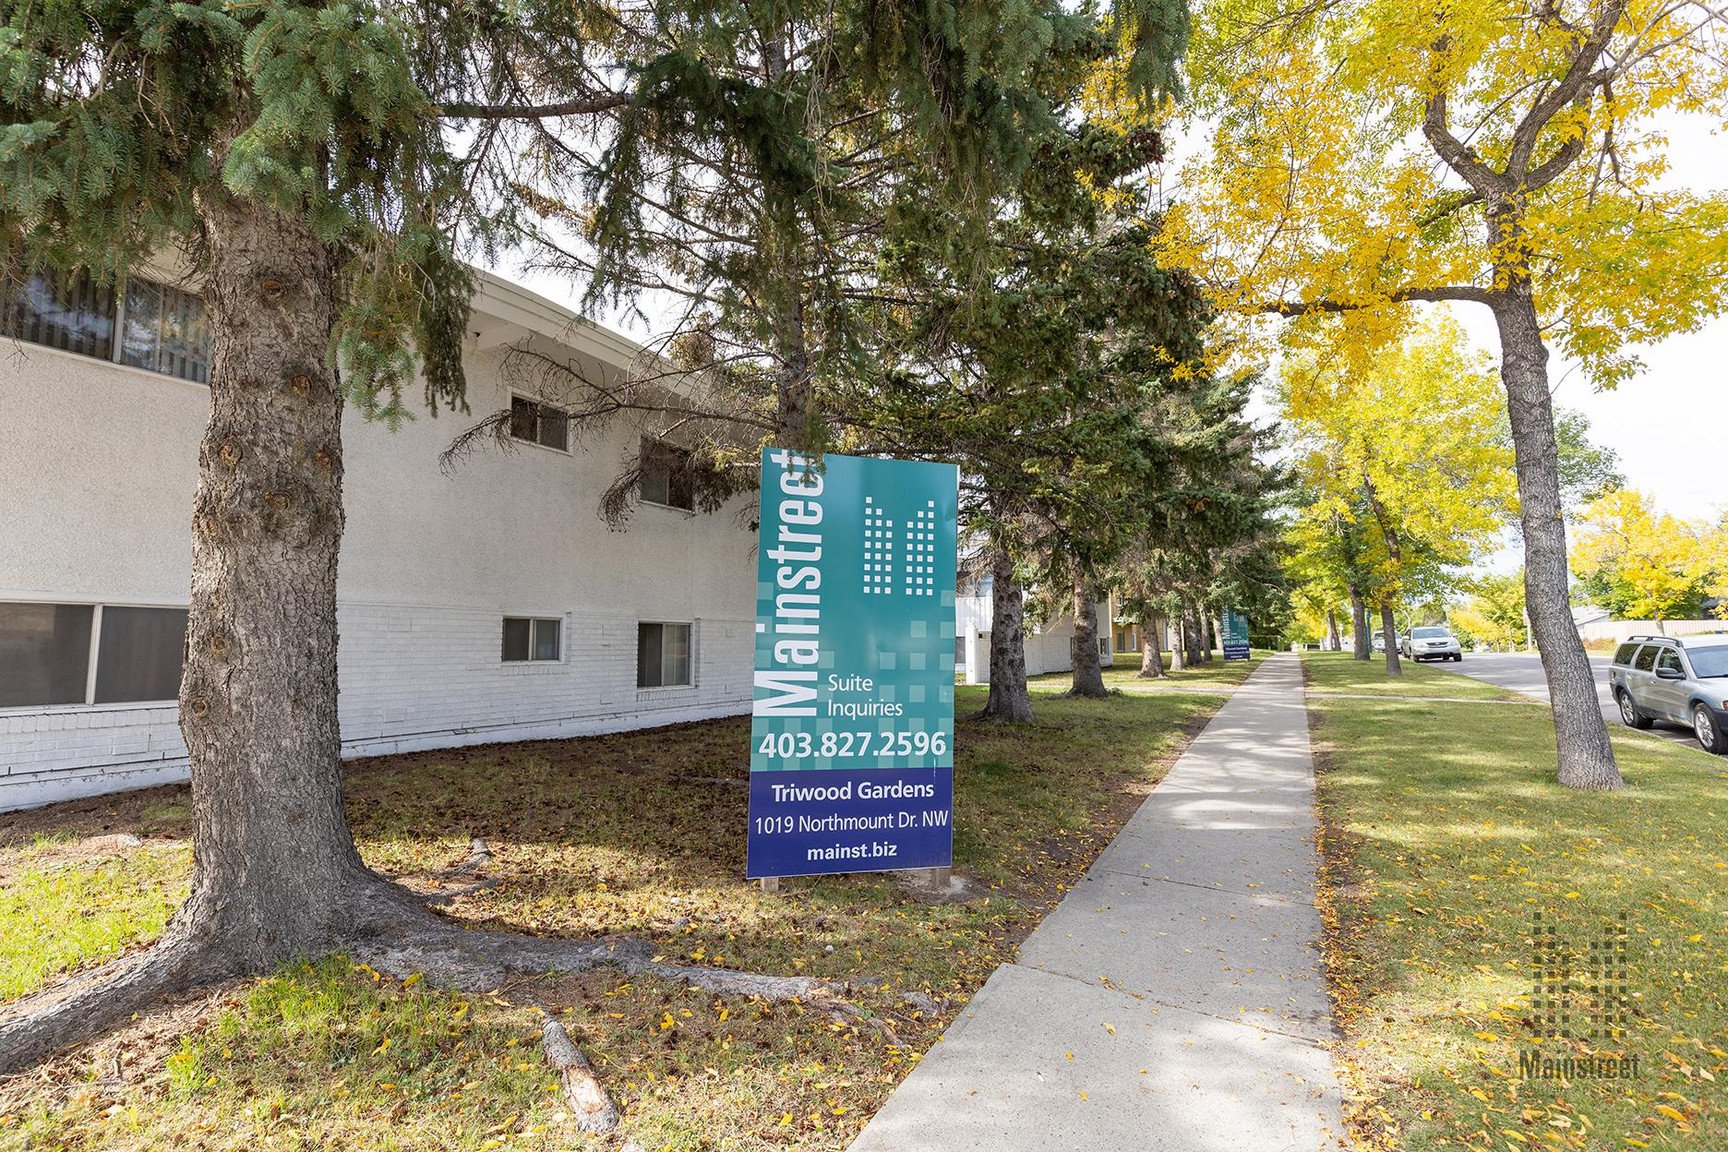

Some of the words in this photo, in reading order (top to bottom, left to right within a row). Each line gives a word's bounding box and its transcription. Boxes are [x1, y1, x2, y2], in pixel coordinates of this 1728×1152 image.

[753, 450, 824, 716] Mainstreet
[828, 674, 873, 691] Suite
[828, 699, 903, 720] Inquiries
[759, 731, 946, 758] 403.827.2596
[772, 782, 851, 802] Triwood
[857, 780, 934, 799] Gardens
[756, 816, 794, 834] 1019
[799, 813, 894, 832] Northmount
[898, 811, 918, 828] Dr.
[922, 811, 949, 827] NW
[807, 841, 897, 861] mainst.biz
